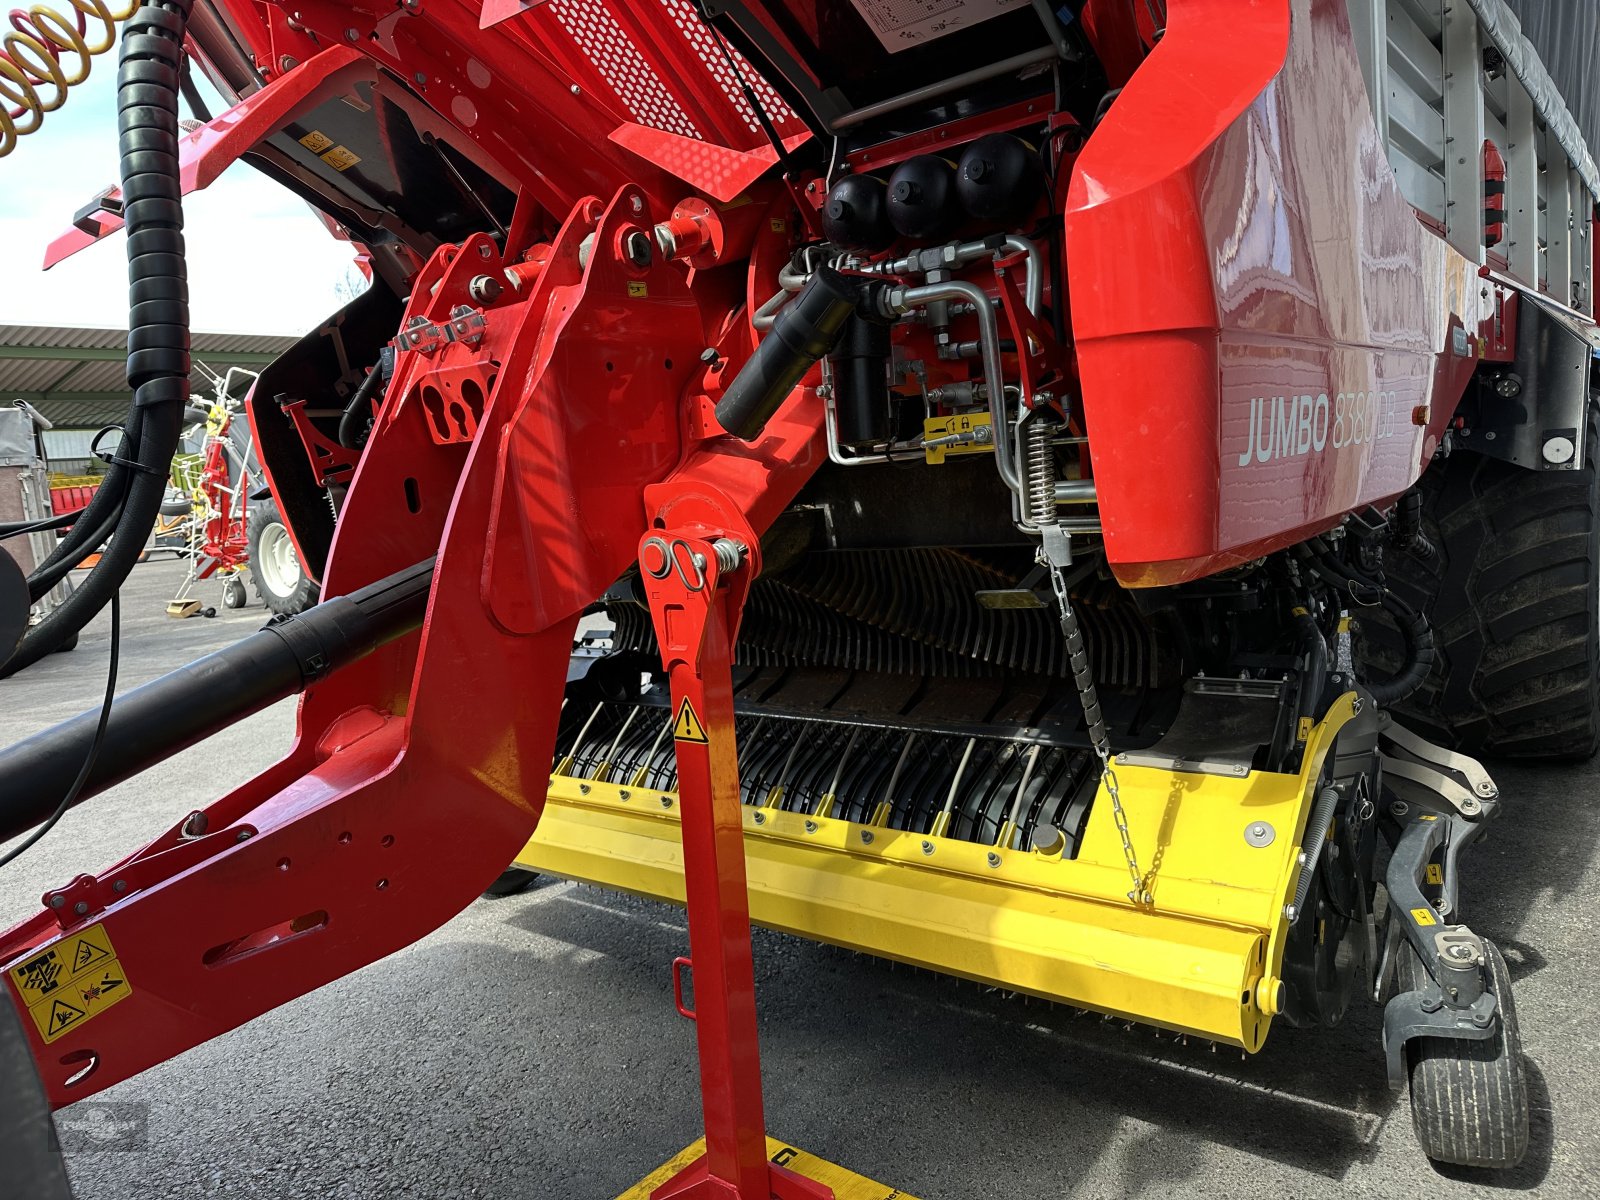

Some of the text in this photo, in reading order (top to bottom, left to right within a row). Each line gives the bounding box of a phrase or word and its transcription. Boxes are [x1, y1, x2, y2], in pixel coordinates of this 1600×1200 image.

[1239, 390, 1396, 467] JUMBO 8380 DB
